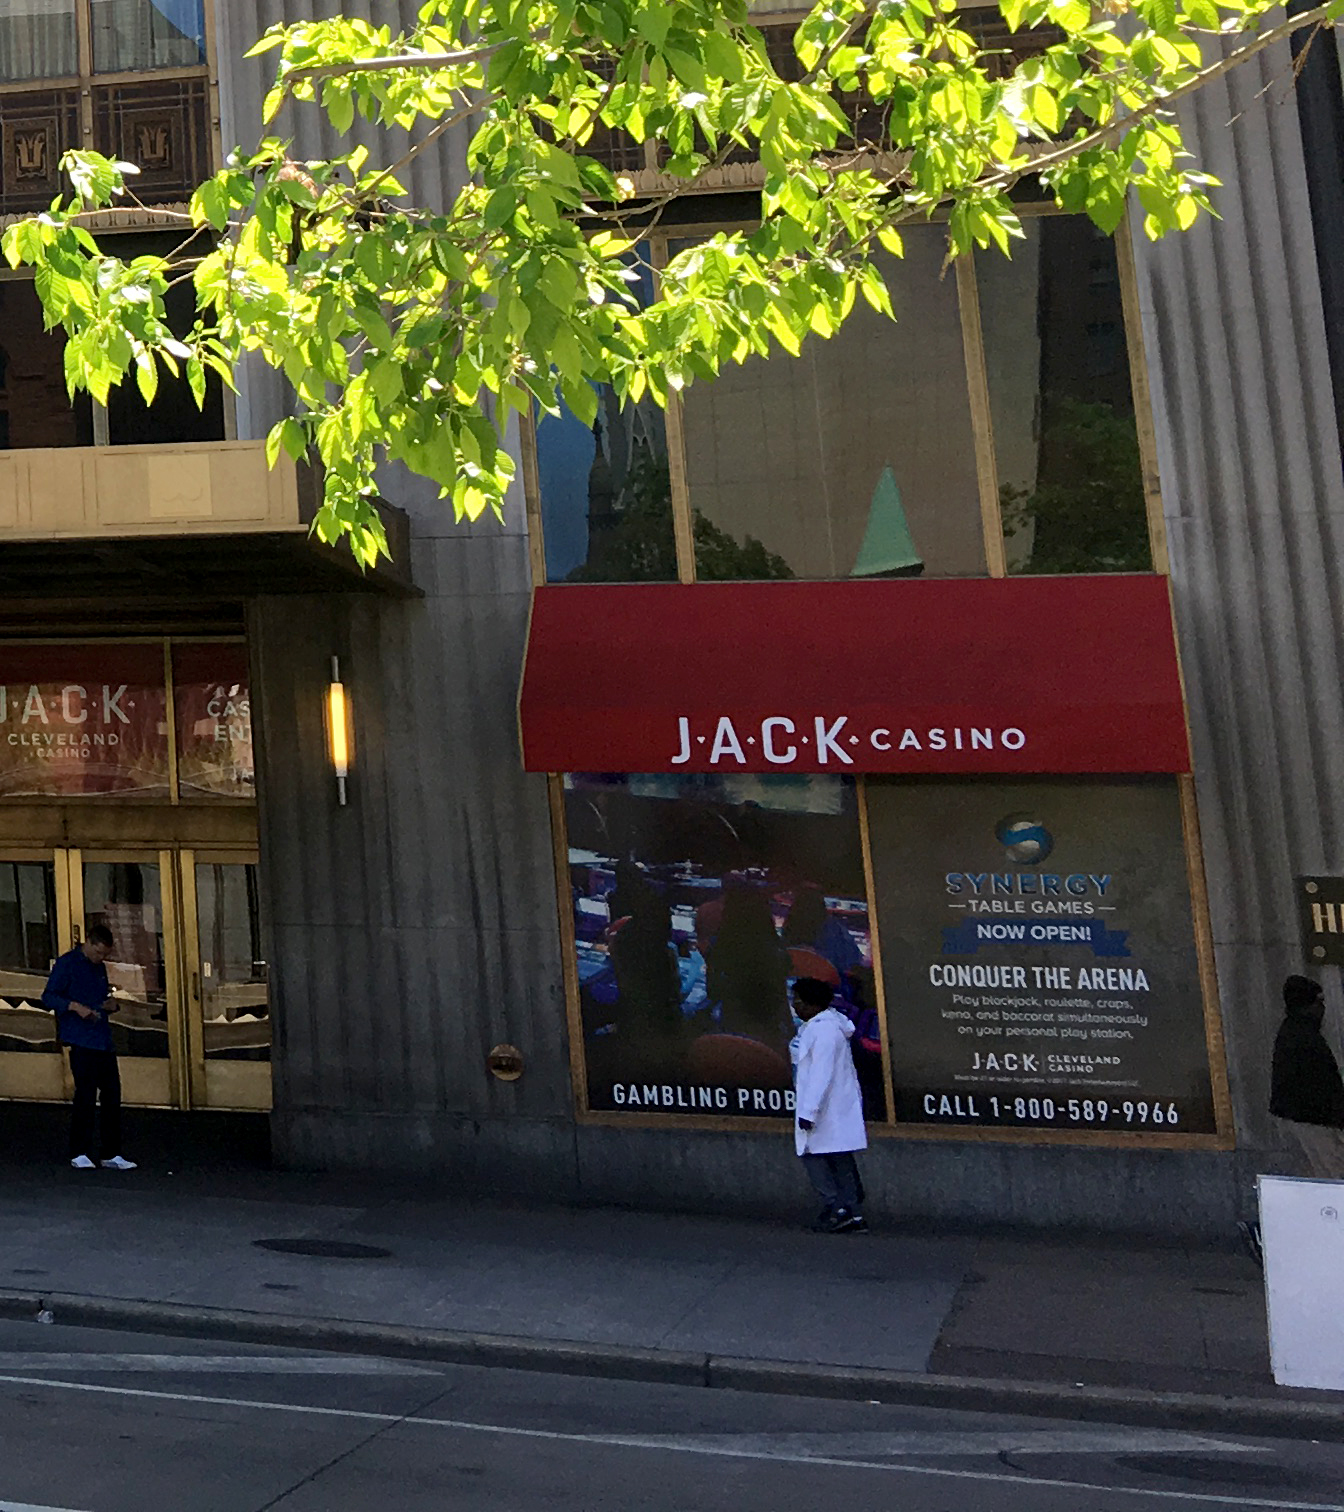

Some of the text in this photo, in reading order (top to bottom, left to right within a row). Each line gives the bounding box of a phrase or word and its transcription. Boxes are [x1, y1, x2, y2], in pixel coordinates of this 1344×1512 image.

[7, 733, 119, 747] CLEVELAND
[870, 727, 1026, 751] CASINO
[36, 747, 91, 759] CASINO
[945, 872, 1112, 896] SYNERGY
[968, 899, 1095, 915] TABLE GAMES
[977, 924, 1092, 941] NOW OPEN!
[929, 964, 1150, 991] CONQUER THE ARENA
[952, 994, 980, 1007] Play
[977, 1010, 1000, 1021] and
[1002, 1010, 1055, 1022] baccarat
[1058, 1013, 1149, 1027] simultaneously
[957, 1025, 974, 1035] on
[976, 1027, 1003, 1037] your
[1006, 1026, 1058, 1038] personal
[1061, 1028, 1088, 1040] play
[1047, 1054, 1121, 1065] CLEVELAND
[1048, 1065, 1094, 1074] CASINO
[613, 1083, 728, 1108] GAMBLING
[923, 1094, 1179, 1125] CALL 1-800-589-9966
